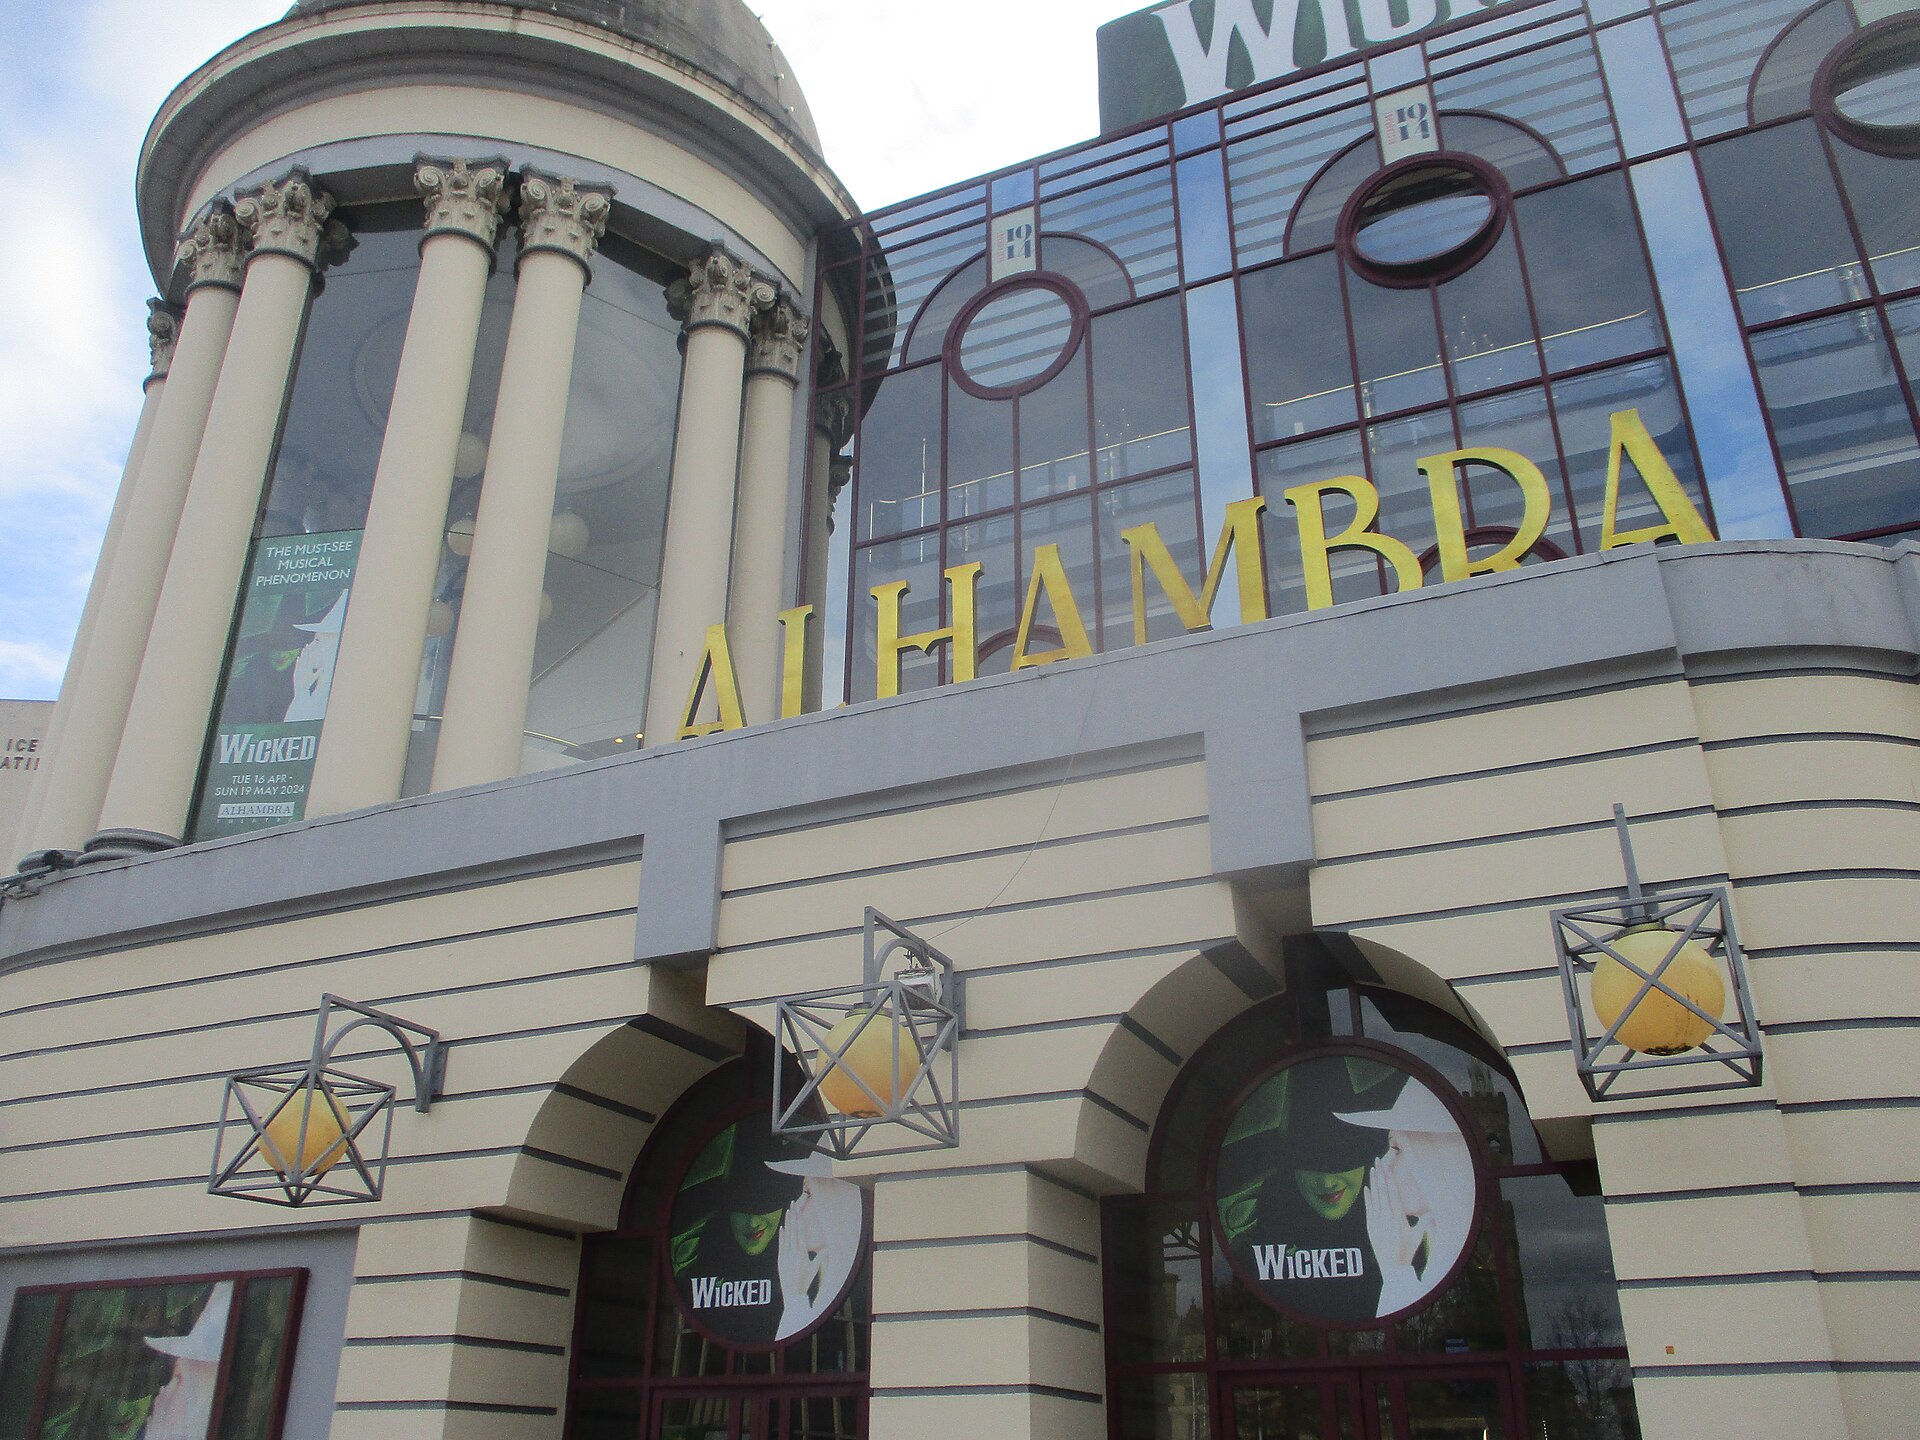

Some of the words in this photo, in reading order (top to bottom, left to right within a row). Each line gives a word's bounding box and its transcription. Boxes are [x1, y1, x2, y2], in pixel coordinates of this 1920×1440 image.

[266, 546, 291, 558] THE
[294, 541, 353, 556] MUST-SEE
[277, 556, 334, 570] MUSICAL
[256, 568, 350, 586] PHENOMENON
[6, 738, 39, 752] ICE
[232, 775, 251, 784] TUE
[254, 775, 265, 784] 16
[267, 774, 287, 783] APR
[214, 787, 237, 796] SUN
[241, 787, 251, 796] 19
[253, 786, 278, 795] MAY
[280, 784, 305, 795] 2024
[221, 805, 292, 816] ALHAMBRA
